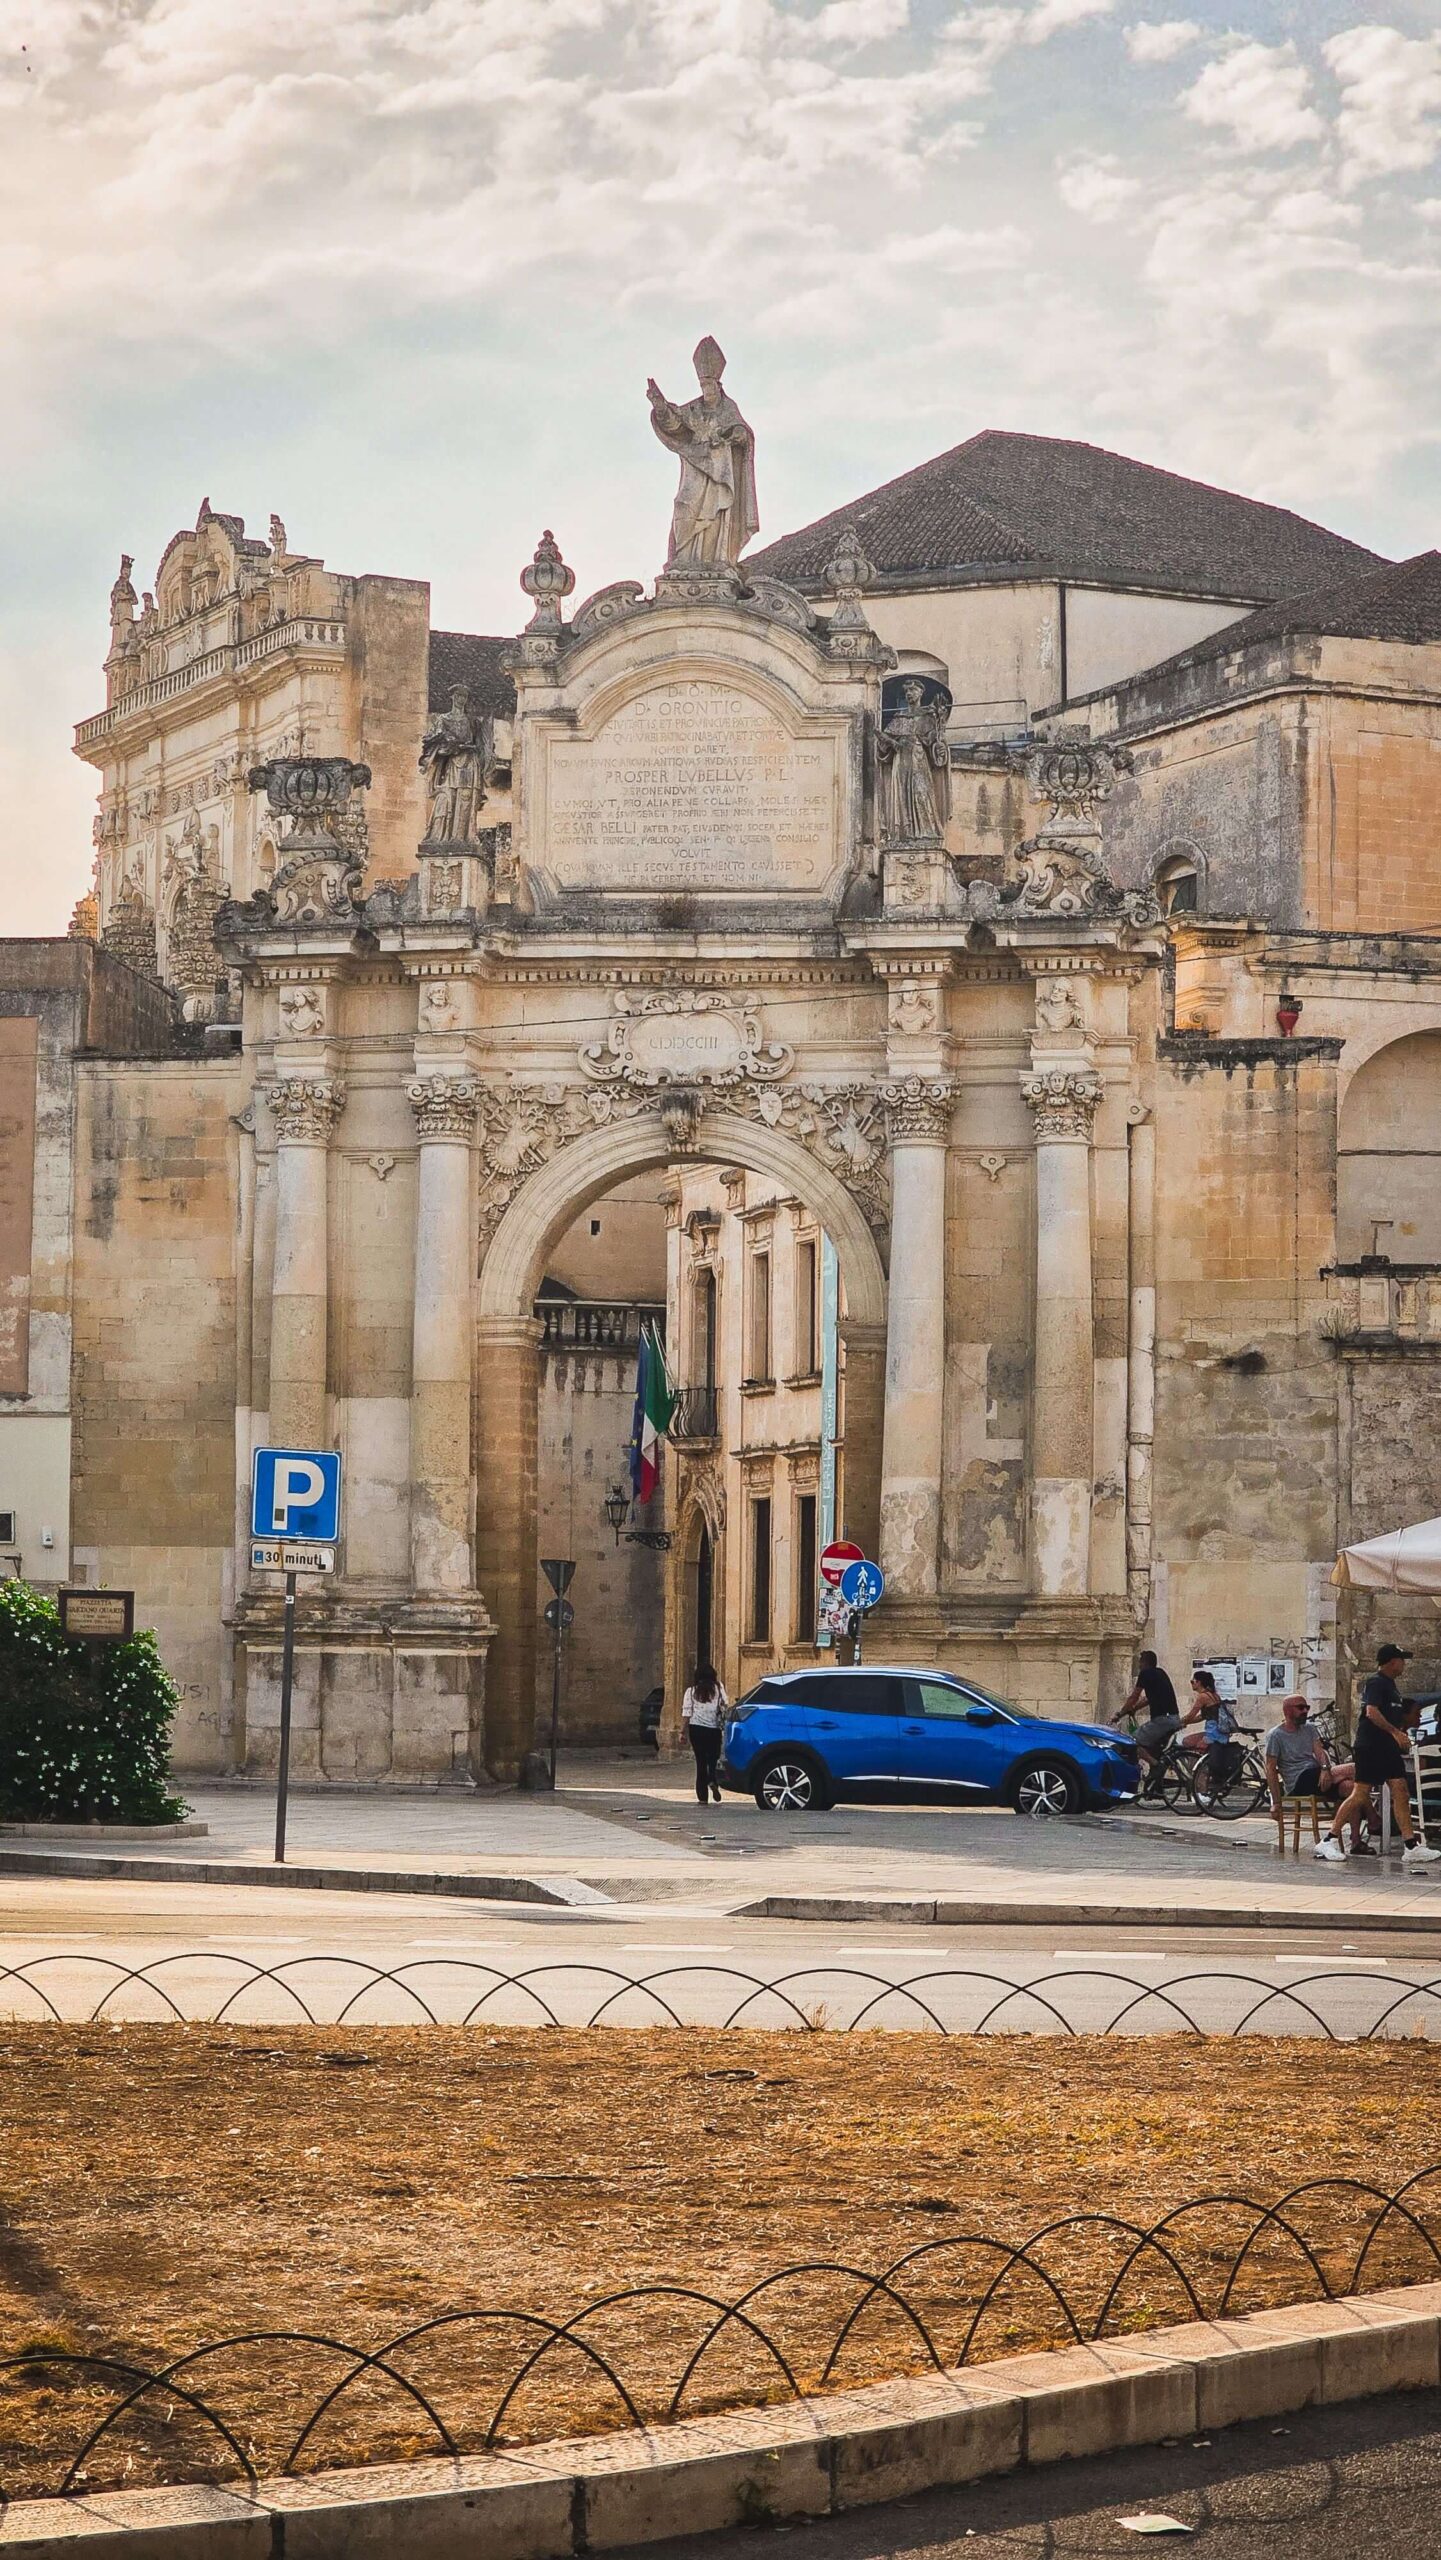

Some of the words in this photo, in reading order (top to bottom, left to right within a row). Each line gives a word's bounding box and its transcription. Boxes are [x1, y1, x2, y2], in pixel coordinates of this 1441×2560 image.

[659, 701, 742, 715] ORONTIO
[605, 770, 669, 783] PROSPER
[678, 769, 755, 782] LVBELLVS
[601, 821, 637, 834] BELLI
[643, 824, 669, 833] PATER
[671, 848, 711, 859] VOLVIT
[644, 862, 674, 872] SECVS
[679, 861, 745, 872] TESTAMENTO
[271, 1458, 325, 1531] P
[265, 1551, 280, 1563] 30
[285, 1553, 323, 1566] minuti
